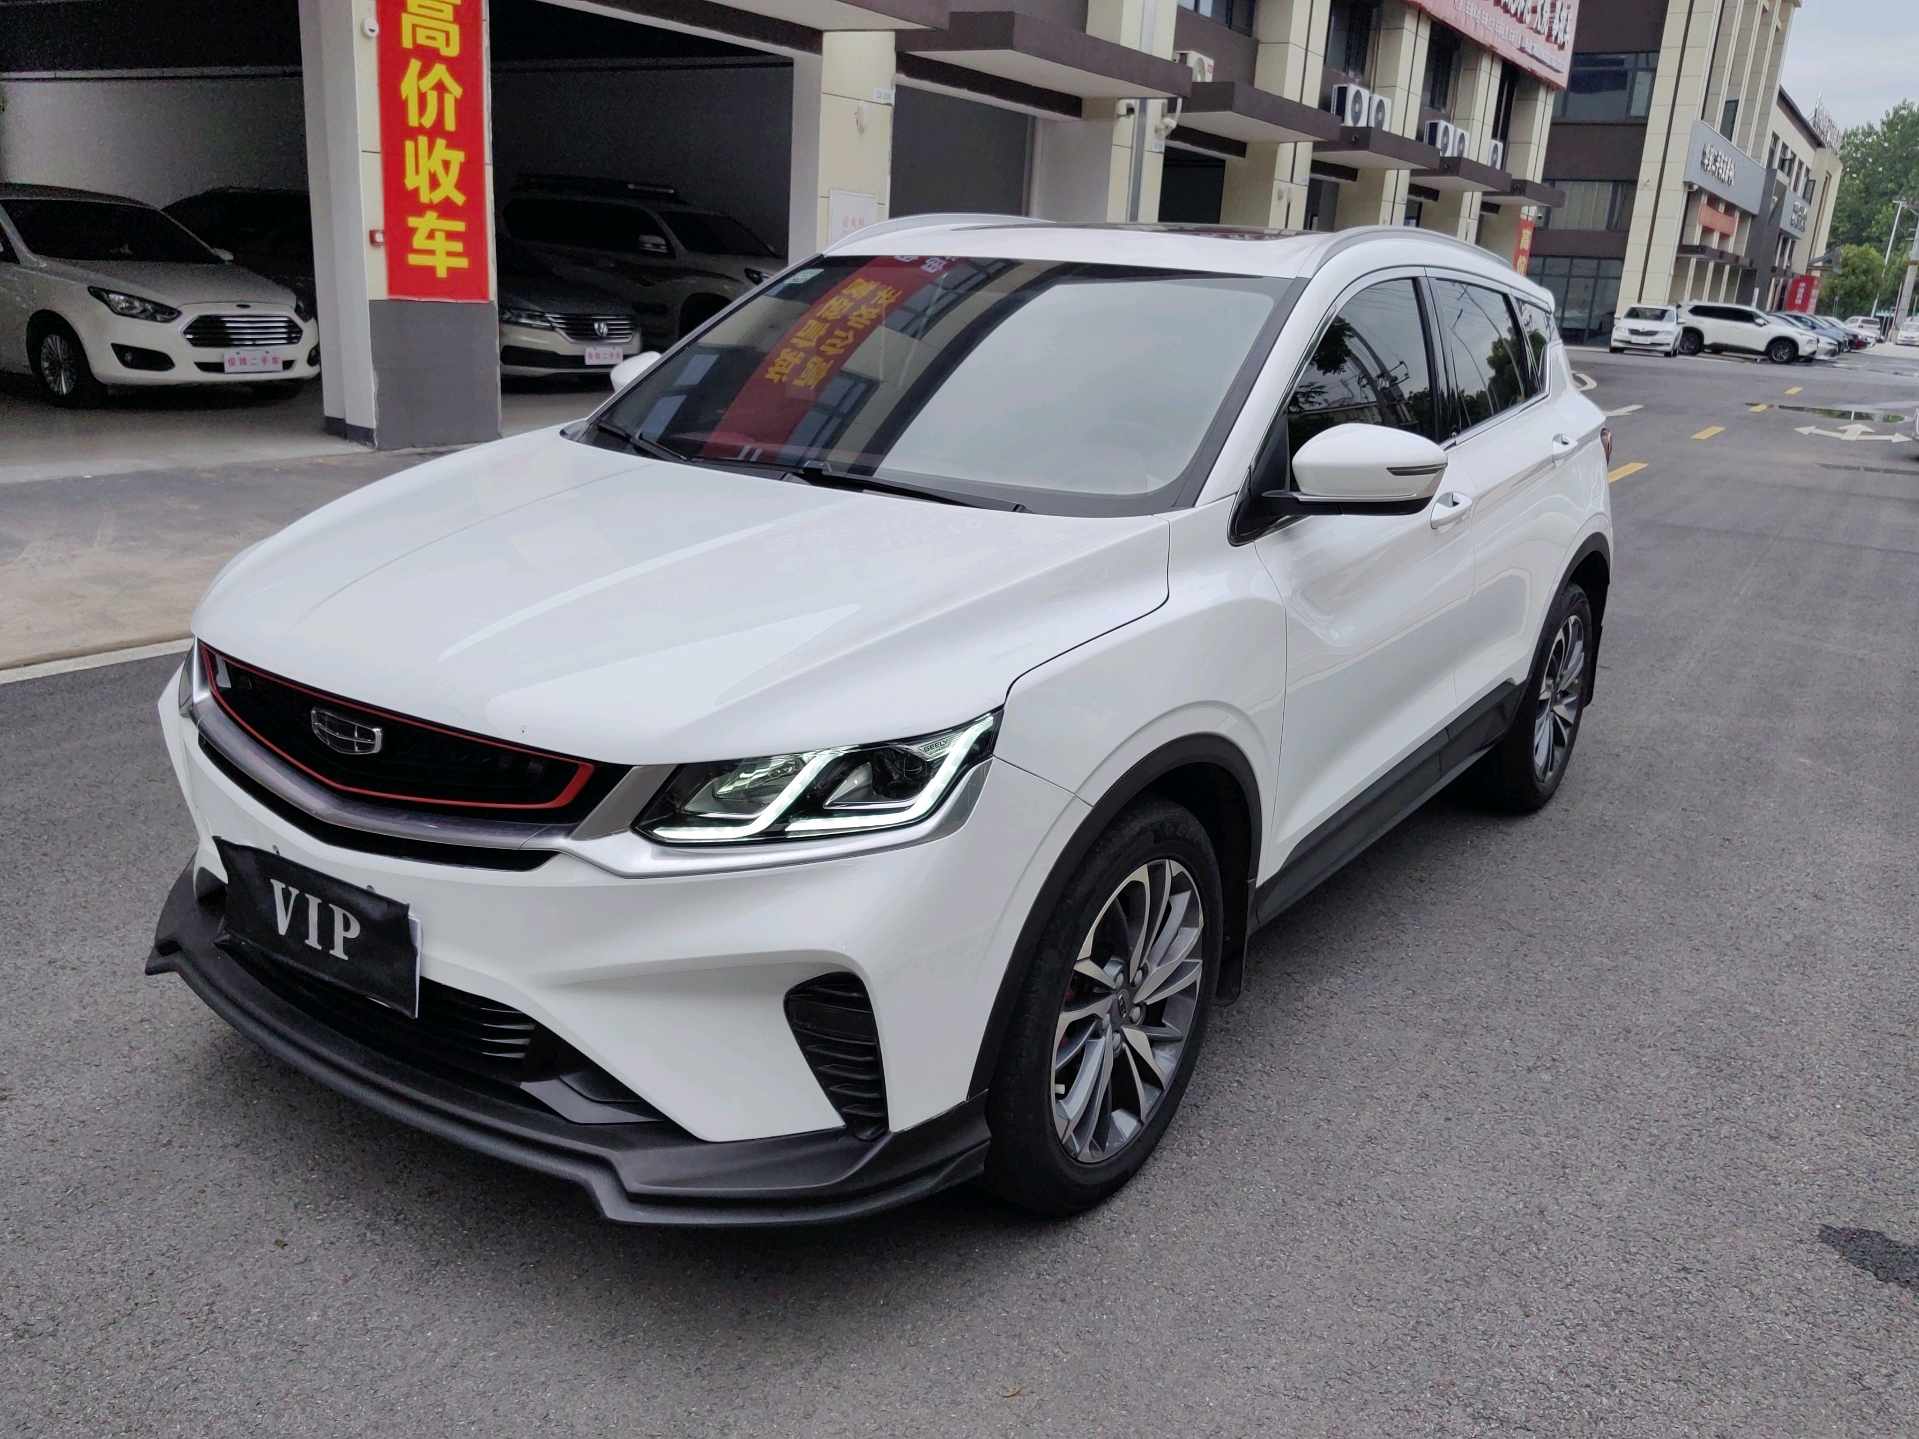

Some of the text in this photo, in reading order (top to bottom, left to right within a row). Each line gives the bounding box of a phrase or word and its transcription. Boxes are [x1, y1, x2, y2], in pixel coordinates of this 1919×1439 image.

[401, 0, 469, 278] 高价收车
[923, 739, 948, 752] GEELY
[270, 879, 361, 960] VIP
